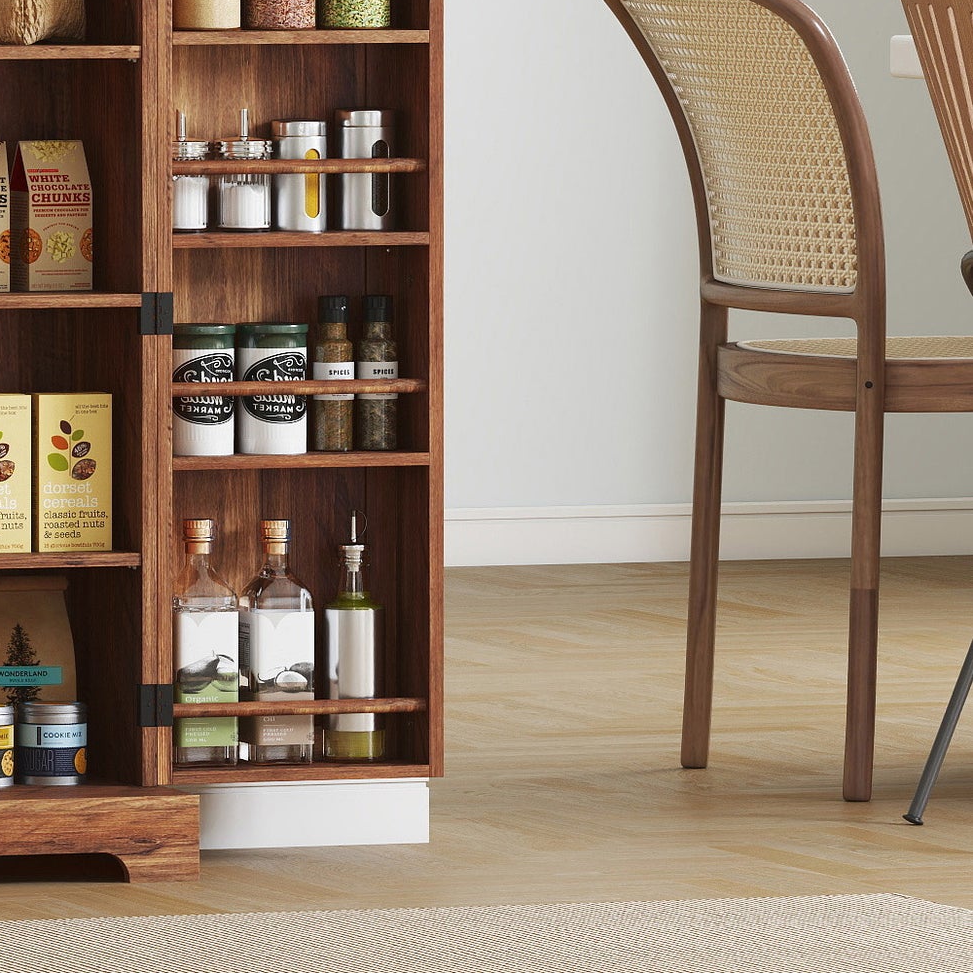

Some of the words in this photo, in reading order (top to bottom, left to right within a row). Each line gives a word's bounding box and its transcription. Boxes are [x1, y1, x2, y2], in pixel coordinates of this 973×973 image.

[28, 174, 70, 183] WHITE
[30, 183, 90, 191] CHOCOLATE
[31, 192, 91, 202] CHUNKS
[43, 481, 93, 494] dorset
[43, 495, 99, 508] cereals
[43, 510, 77, 519] classic
[79, 510, 108, 519] fruits,
[43, 520, 80, 528] roasted
[82, 520, 105, 528] nuts
[43, 530, 53, 538] &
[54, 530, 81, 538] seeds
[185, 695, 219, 704] Organic
[24, 748, 54, 771] SUGAR
